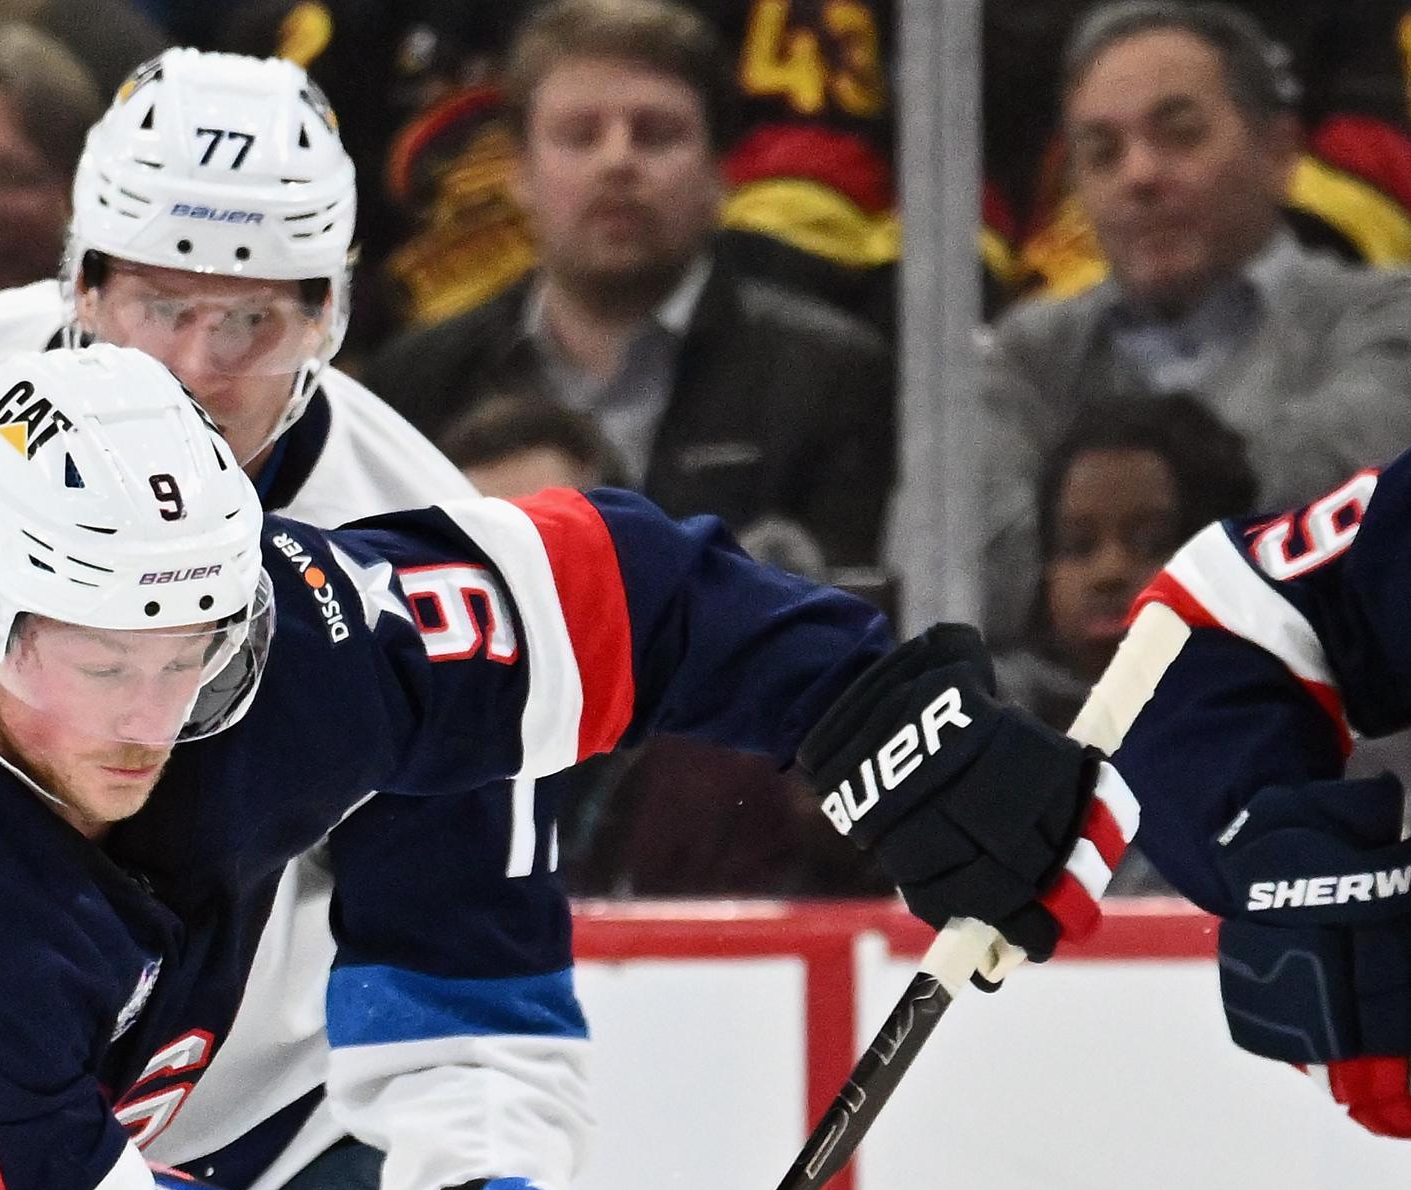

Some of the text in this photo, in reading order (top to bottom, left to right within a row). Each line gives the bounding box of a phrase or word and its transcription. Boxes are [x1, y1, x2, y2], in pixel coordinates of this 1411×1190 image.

[196, 127, 256, 170] 77
[170, 203, 264, 225] BAUER
[148, 473, 188, 521] 9
[139, 564, 223, 585] BAUER
[271, 531, 350, 646] DISCOVER
